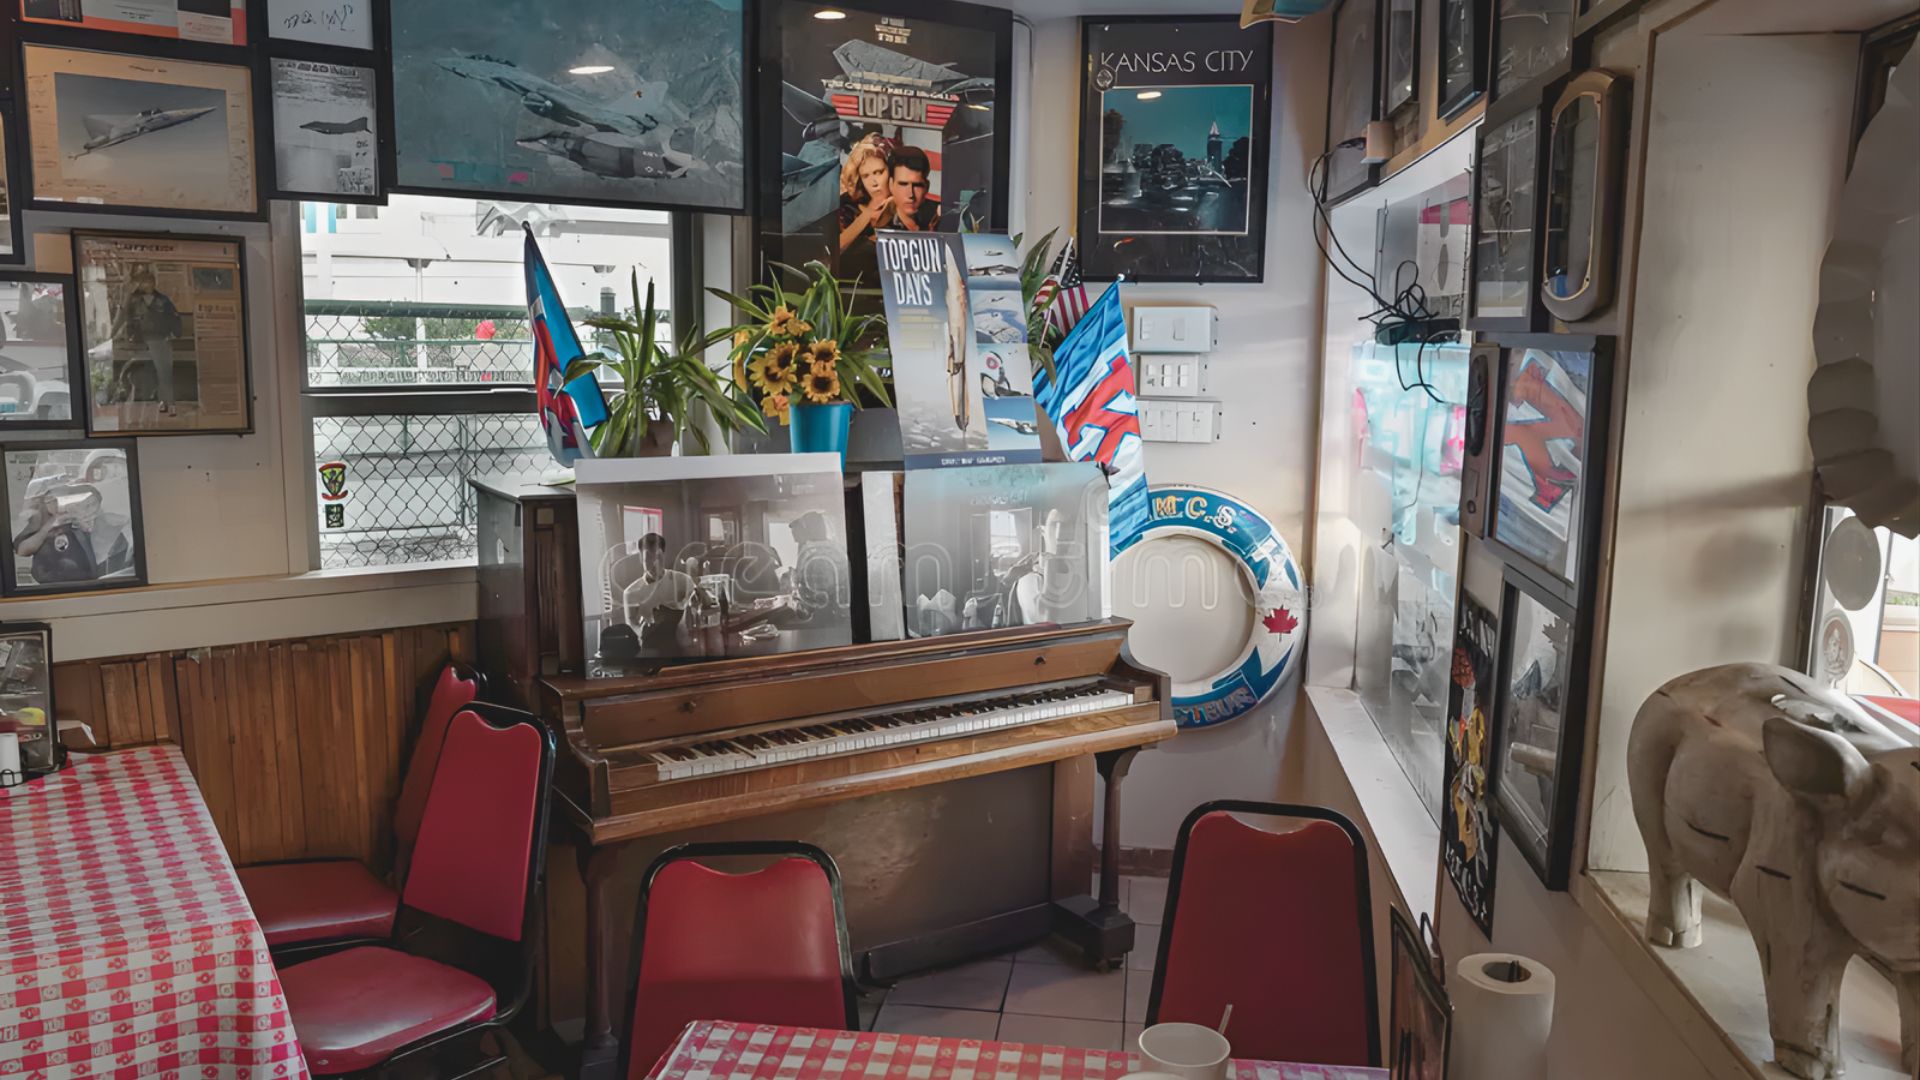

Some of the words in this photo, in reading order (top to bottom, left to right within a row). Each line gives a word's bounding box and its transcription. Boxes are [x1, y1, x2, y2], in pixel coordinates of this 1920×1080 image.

[1101, 51, 1196, 73] KANSAS
[1205, 50, 1254, 72] CITY
[858, 91, 889, 119] TOP
[891, 94, 927, 123] GUN
[877, 238, 942, 273] TOPGUN
[893, 271, 933, 306] DAYS
